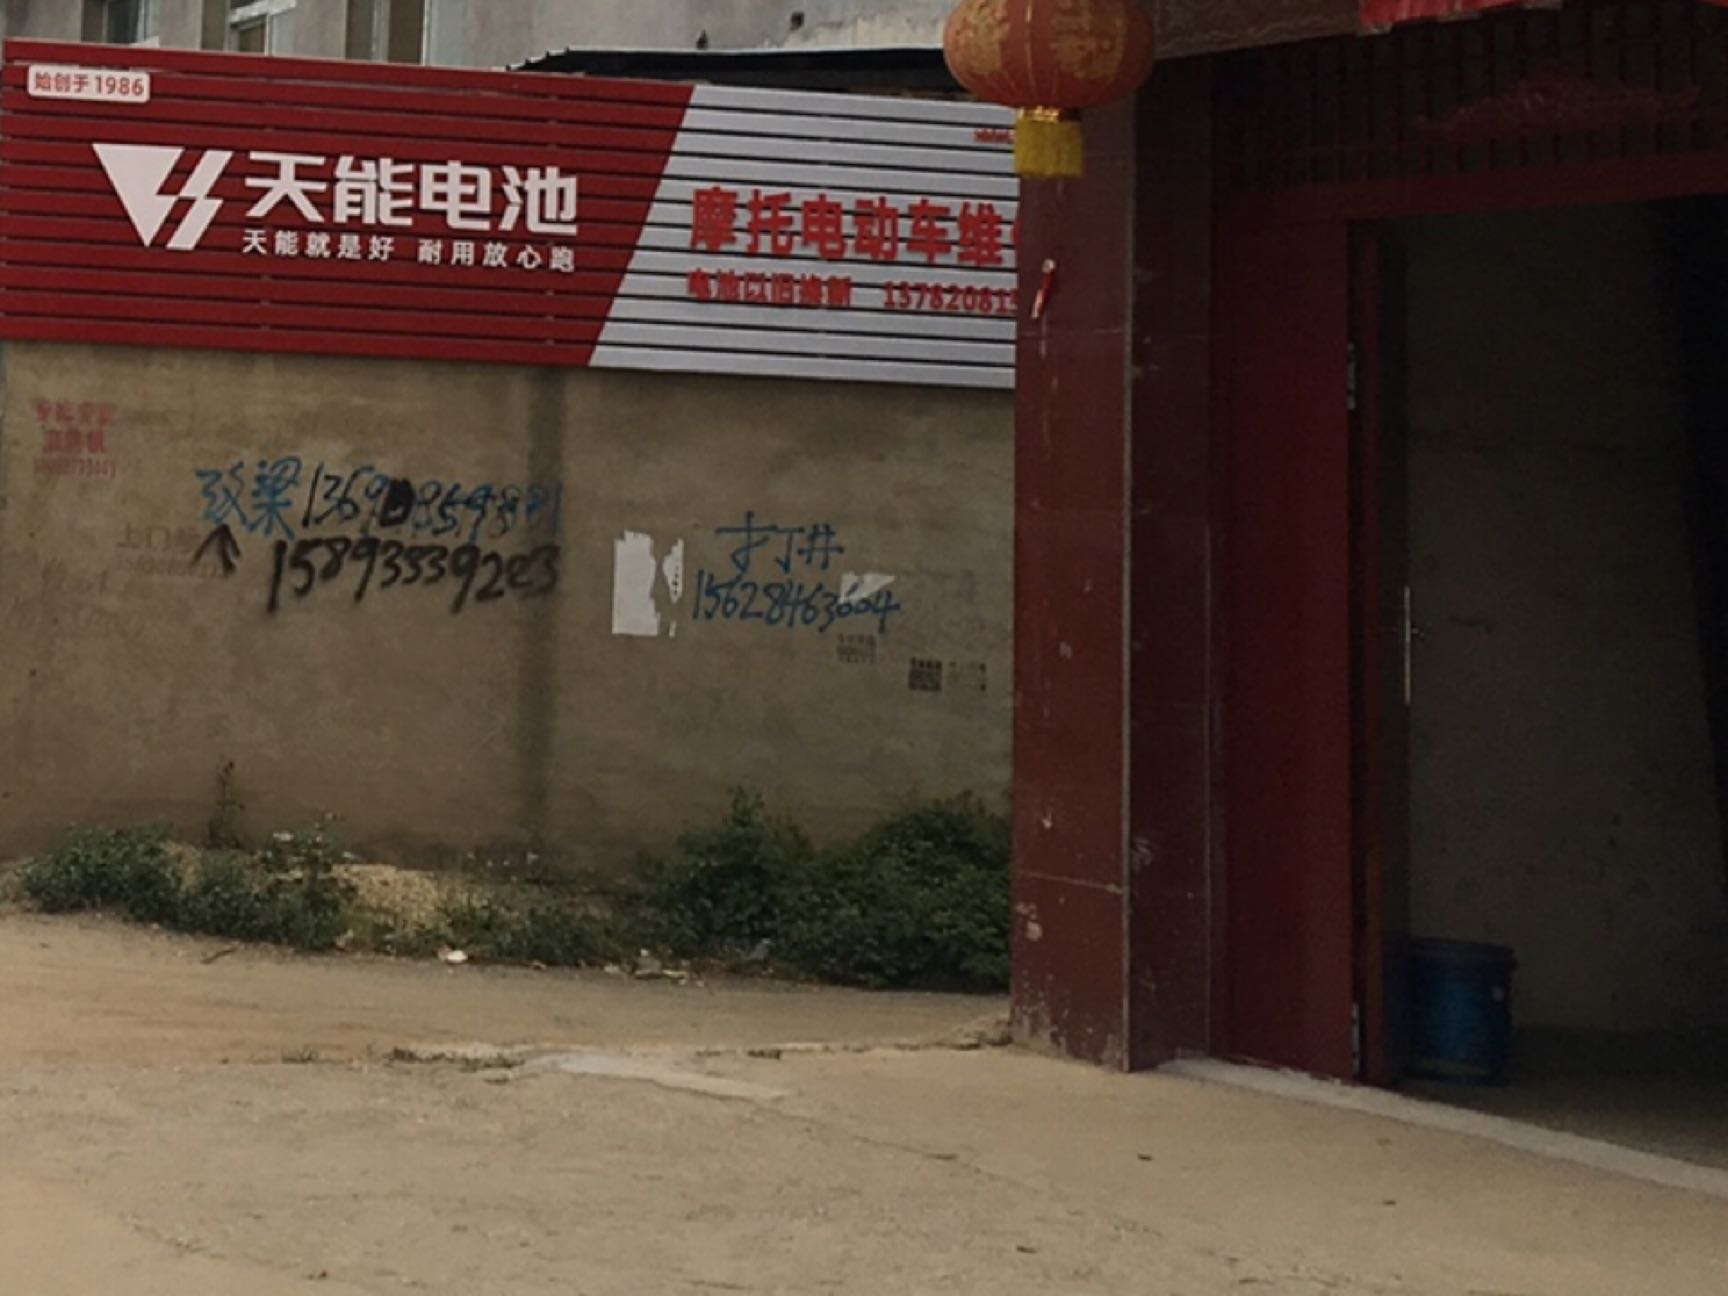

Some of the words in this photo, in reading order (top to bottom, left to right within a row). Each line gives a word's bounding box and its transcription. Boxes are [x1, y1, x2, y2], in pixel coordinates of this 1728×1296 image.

[35, 71, 89, 93] 始创于
[95, 75, 144, 96] 1986
[244, 150, 577, 236] 天能电池
[690, 186, 1019, 267] 摩托电动车维
[242, 229, 396, 262] 天能就是好
[417, 238, 575, 273] 耐用放心跑
[688, 268, 851, 306] 电池以旧换新
